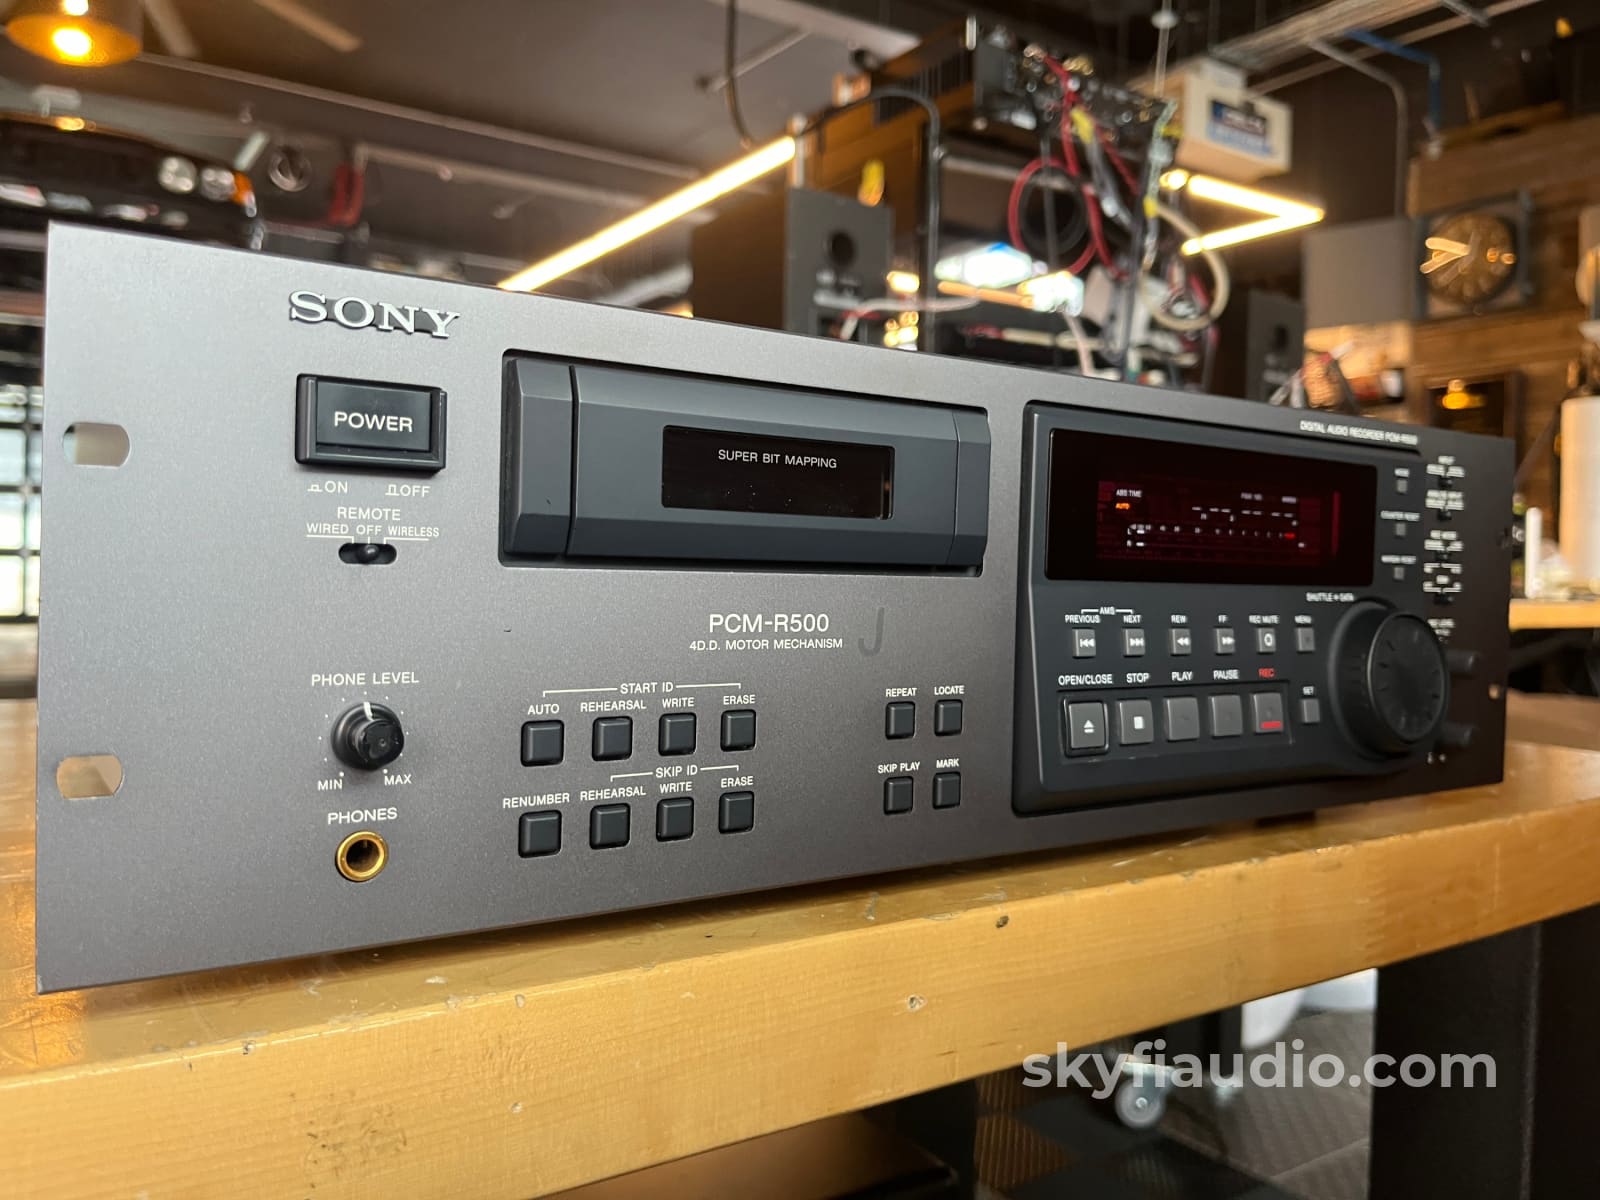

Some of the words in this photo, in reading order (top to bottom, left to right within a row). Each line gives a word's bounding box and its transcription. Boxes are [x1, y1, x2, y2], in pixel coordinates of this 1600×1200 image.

[289, 289, 460, 339] SONY
[333, 410, 414, 433] POWER
[718, 449, 758, 463] SUPER
[762, 453, 780, 465] BIT
[785, 455, 837, 469] MAPPING
[324, 480, 348, 493] ON
[399, 486, 430, 498] OFF
[337, 506, 401, 520] REMOTE
[306, 523, 349, 535] WIRED
[356, 525, 382, 536] OFF
[387, 526, 440, 538] WIRELESS
[1100, 606, 1115, 616] AMS
[708, 613, 830, 634] PCM-R500
[1064, 614, 1101, 624] PREVIOUS
[1123, 614, 1141, 624] NEXT
[1170, 614, 1187, 624] REW
[1218, 614, 1228, 624] FF
[689, 640, 721, 651] 4D.D.
[725, 639, 769, 650] MOTOR
[773, 638, 843, 649] MECHANISM
[311, 673, 366, 687] PHONE
[372, 671, 420, 684] LEVEL
[1126, 672, 1150, 683] STOP
[1171, 671, 1193, 682] PLAY
[1213, 669, 1240, 680] PAUSE
[1258, 668, 1275, 678] REC
[1058, 674, 1113, 685] OPEN/CLOSE
[620, 682, 658, 694] START
[662, 682, 674, 692] ID
[885, 687, 917, 697] REPEAT
[934, 685, 965, 695] LOCATE
[580, 699, 647, 713] REHEARSAL
[662, 697, 695, 709] WRITE
[723, 695, 756, 705] ERASE
[527, 704, 560, 715] AUTO
[877, 764, 898, 774] SKIP
[900, 761, 921, 772] PLAY
[936, 758, 960, 768] MARK
[655, 766, 683, 778] SKIP
[687, 765, 698, 776] ID
[318, 779, 343, 791] MIN
[384, 774, 412, 786] MAX
[720, 776, 754, 788] ERASE
[580, 786, 647, 801] REHEARSAL
[660, 782, 692, 794] WRITE
[502, 793, 570, 809] RENUMBER
[327, 807, 398, 825] PHONES
